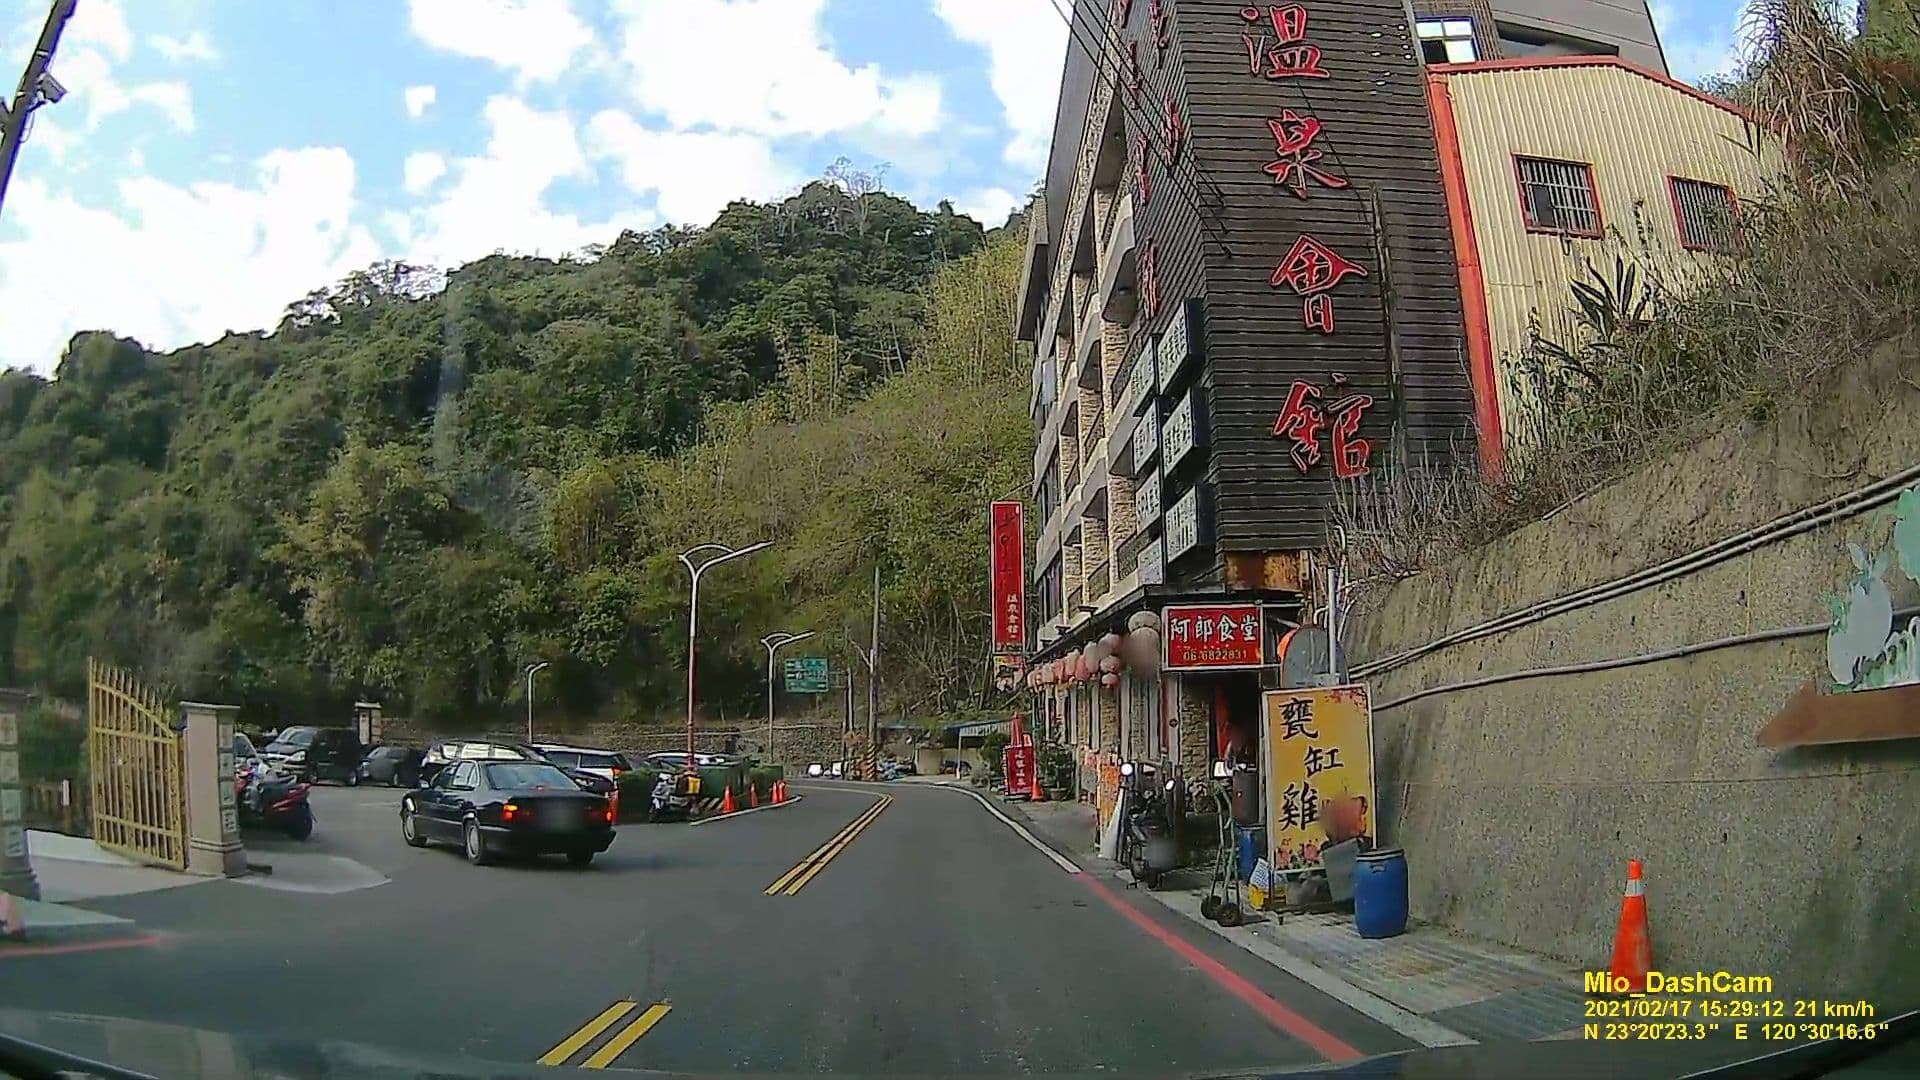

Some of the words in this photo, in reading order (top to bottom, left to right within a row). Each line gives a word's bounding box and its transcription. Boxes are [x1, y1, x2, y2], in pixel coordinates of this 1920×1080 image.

[1241, 3, 1374, 479] 溫泉會館
[1169, 614, 1260, 643] 阿郎食堂
[1277, 696, 1345, 832] 甕缸雞
